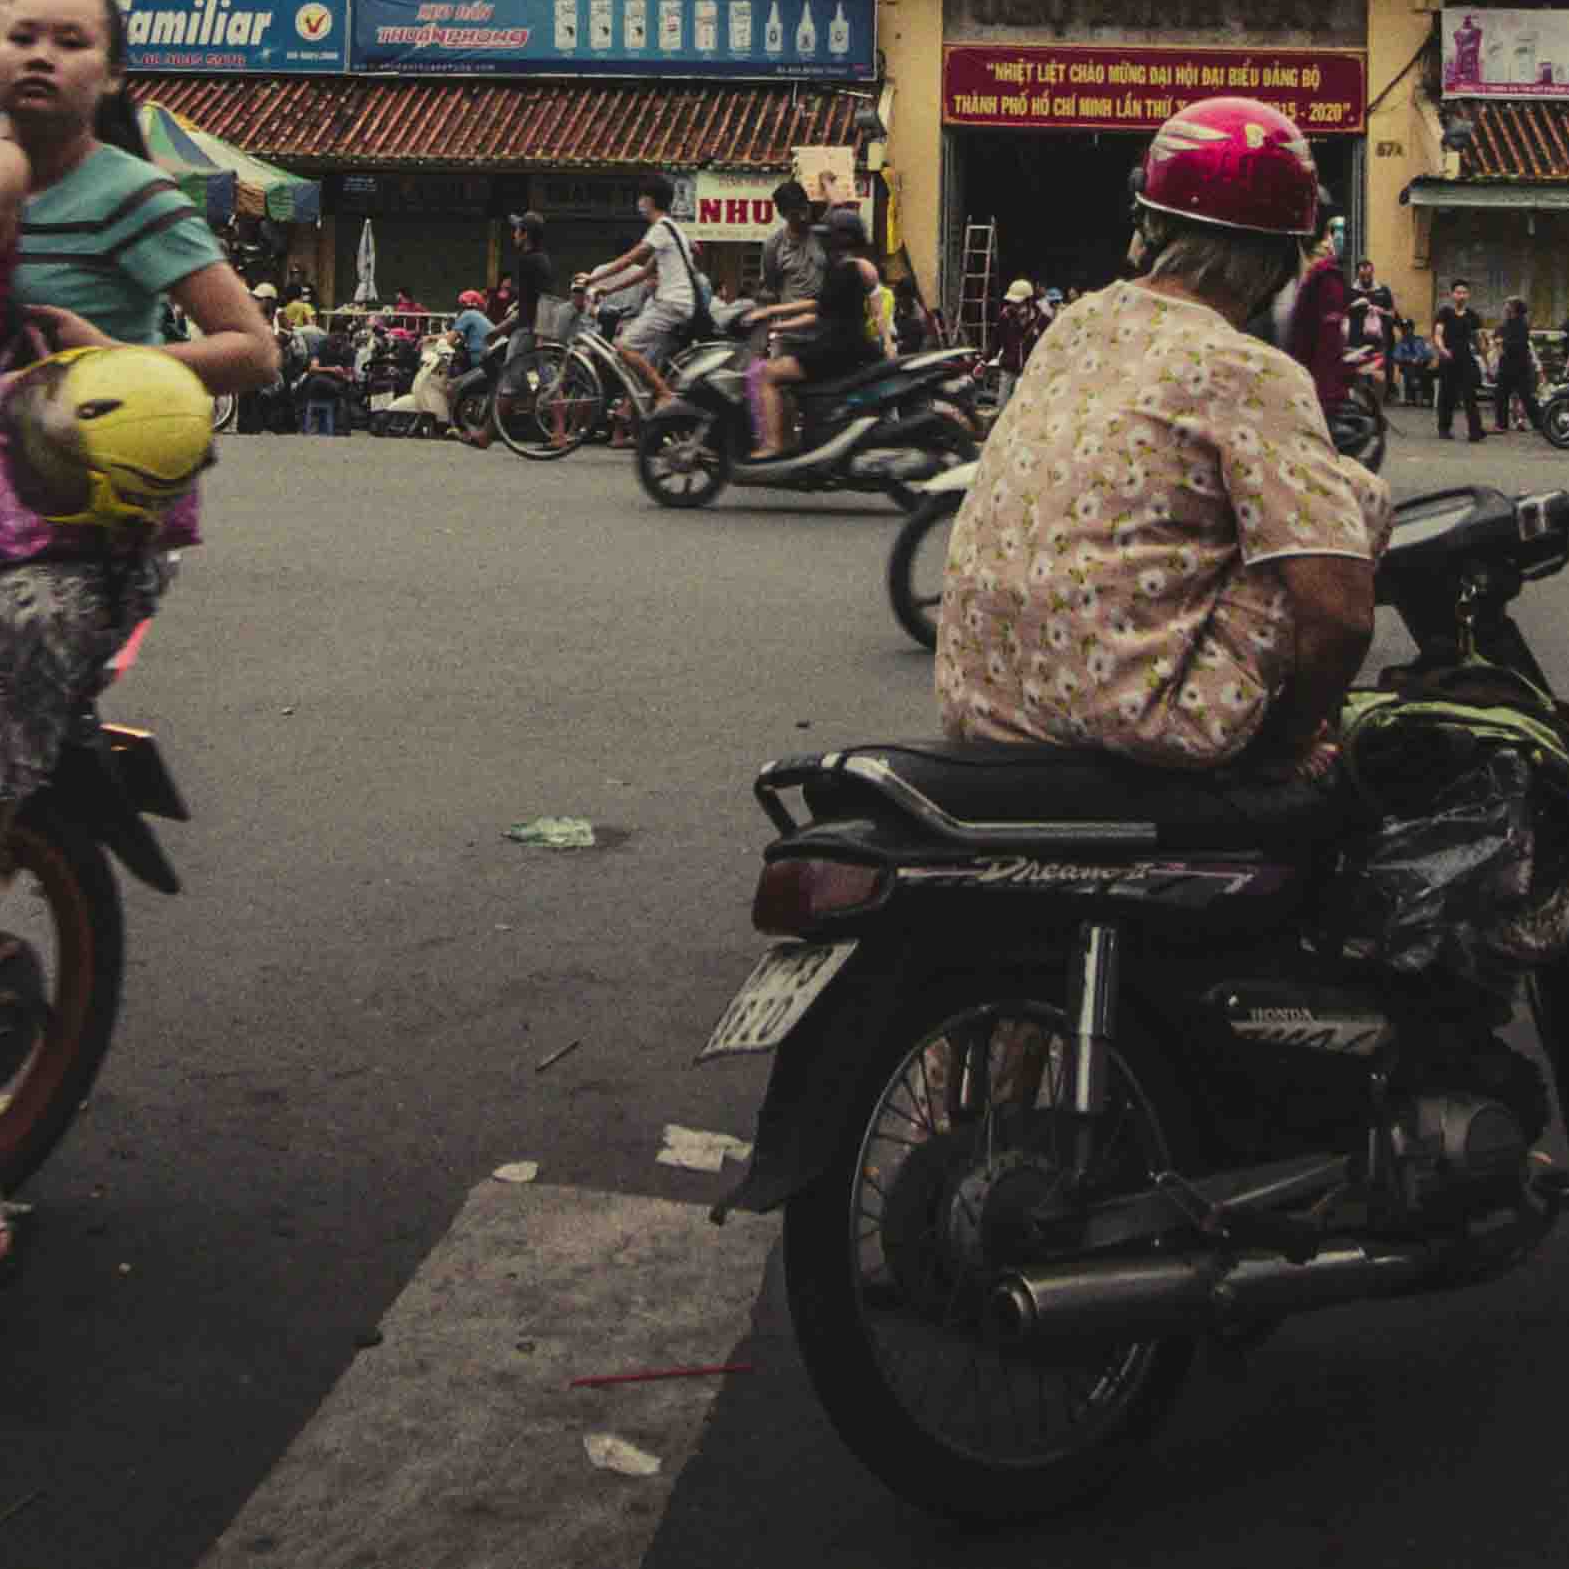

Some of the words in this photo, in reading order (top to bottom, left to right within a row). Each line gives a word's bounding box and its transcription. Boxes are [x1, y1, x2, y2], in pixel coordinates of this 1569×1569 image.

[952, 89, 999, 115] THÀNH
[1001, 88, 1030, 116] PHỐ
[1053, 92, 1077, 117] CHÍ
[1079, 97, 1113, 117] MINH
